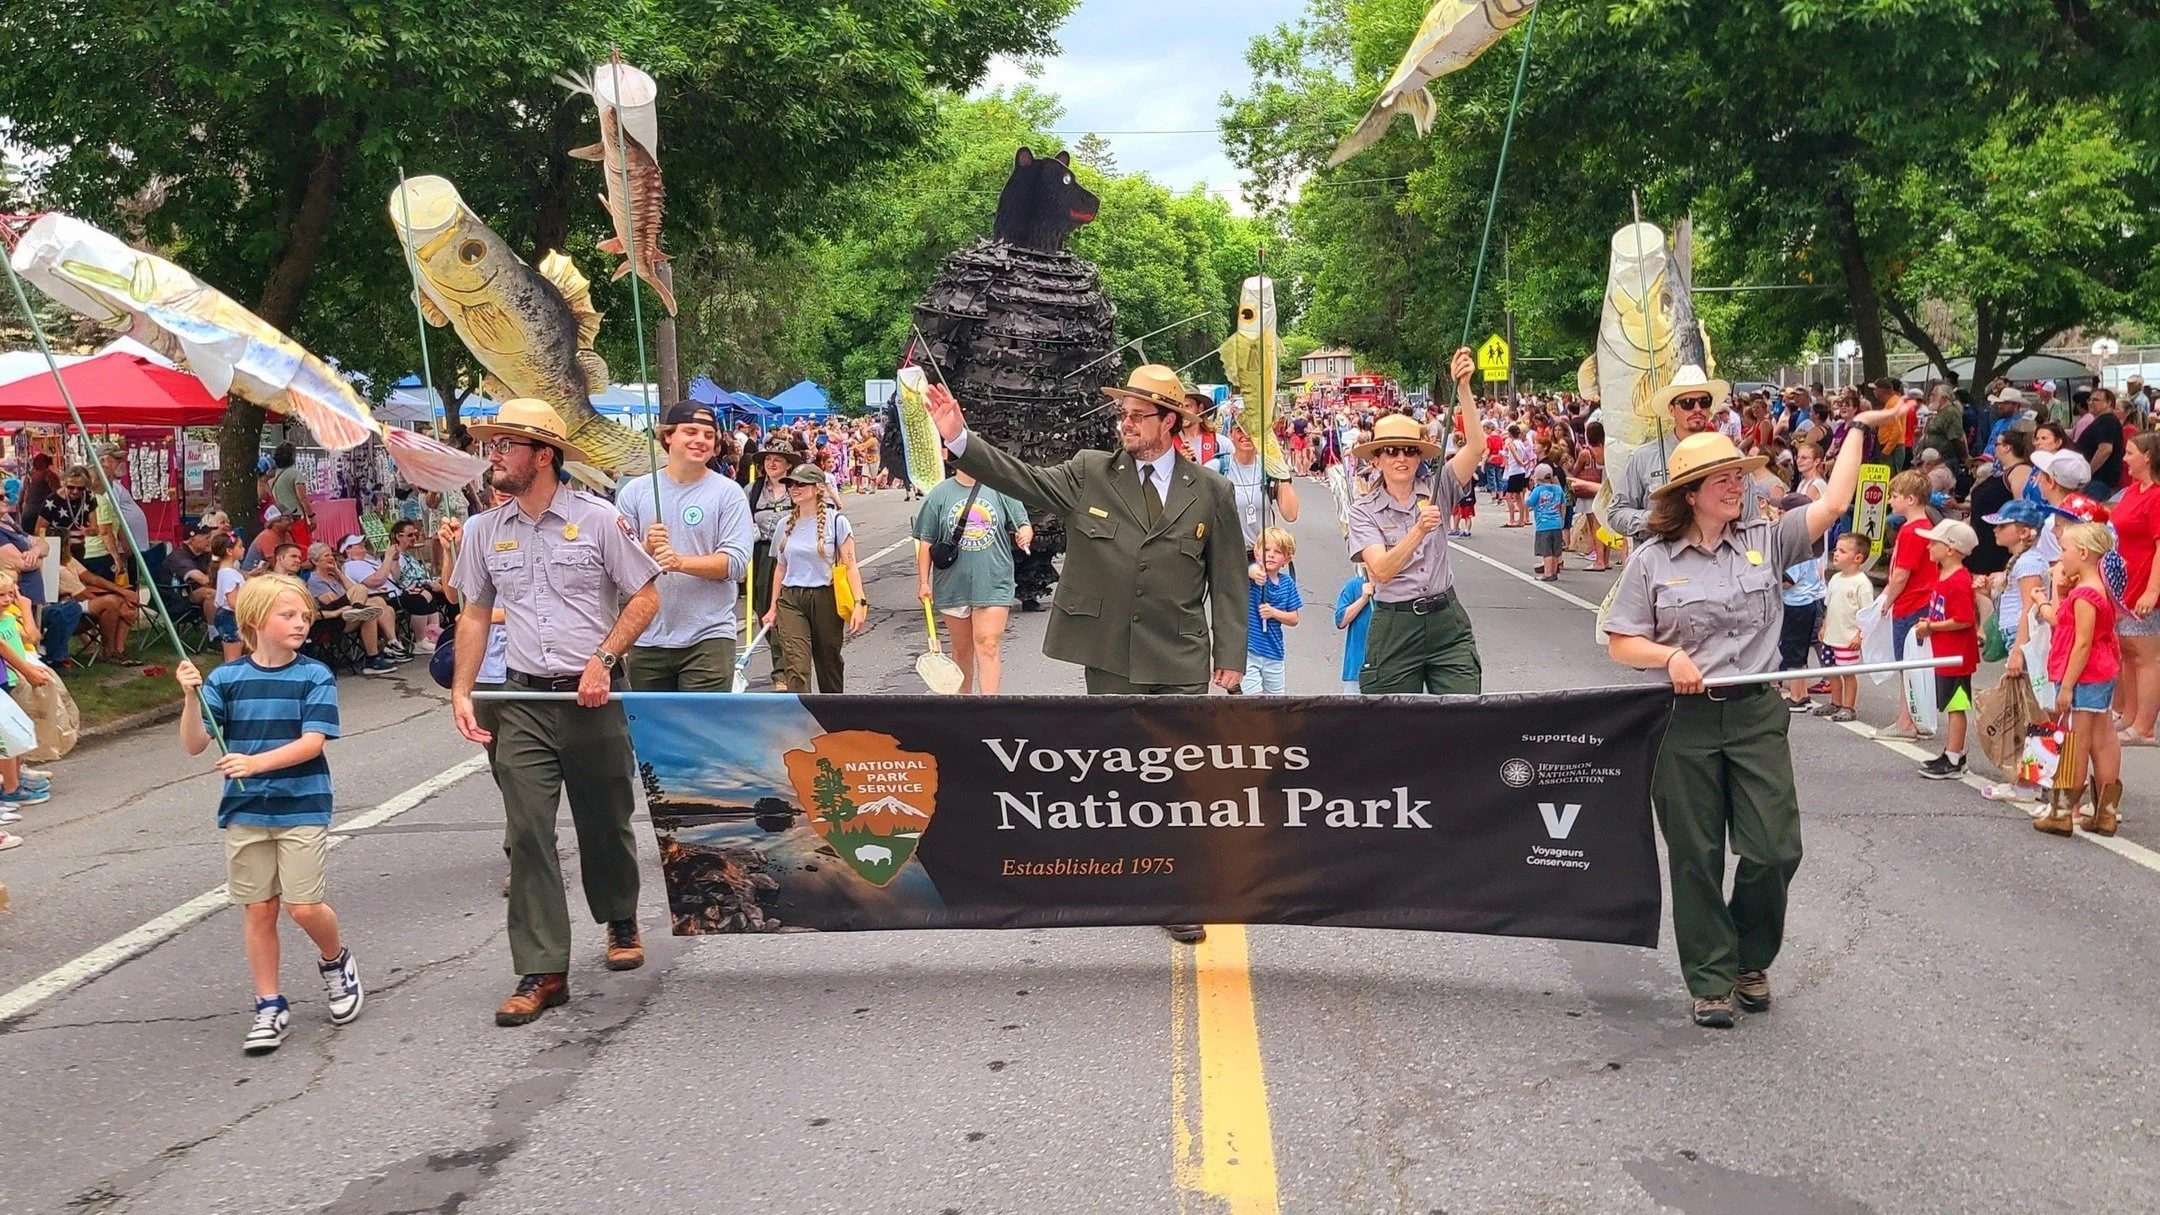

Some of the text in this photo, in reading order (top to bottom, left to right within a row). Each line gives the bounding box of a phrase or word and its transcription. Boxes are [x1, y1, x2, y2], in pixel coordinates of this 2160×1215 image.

[1867, 467, 1885, 475] STATE
[1865, 491, 1882, 499] STOP
[1589, 734, 1604, 747] by
[845, 760, 928, 772] NATIONAL
[981, 738, 1310, 783] Voyageurs
[1537, 761, 1592, 772] JEFFERSON
[866, 771, 910, 782] PARK
[1538, 767, 1621, 779] NATIONAL PARKS
[1538, 776, 1605, 786] ASSOCIATION
[857, 783, 924, 794] SERVICE
[992, 786, 1434, 829] National Park
[1537, 802, 1582, 840] V
[1531, 845, 1584, 858] Voyageurs
[1001, 857, 1175, 877] Estasblished 1975
[1526, 856, 1591, 871] Conservancy
